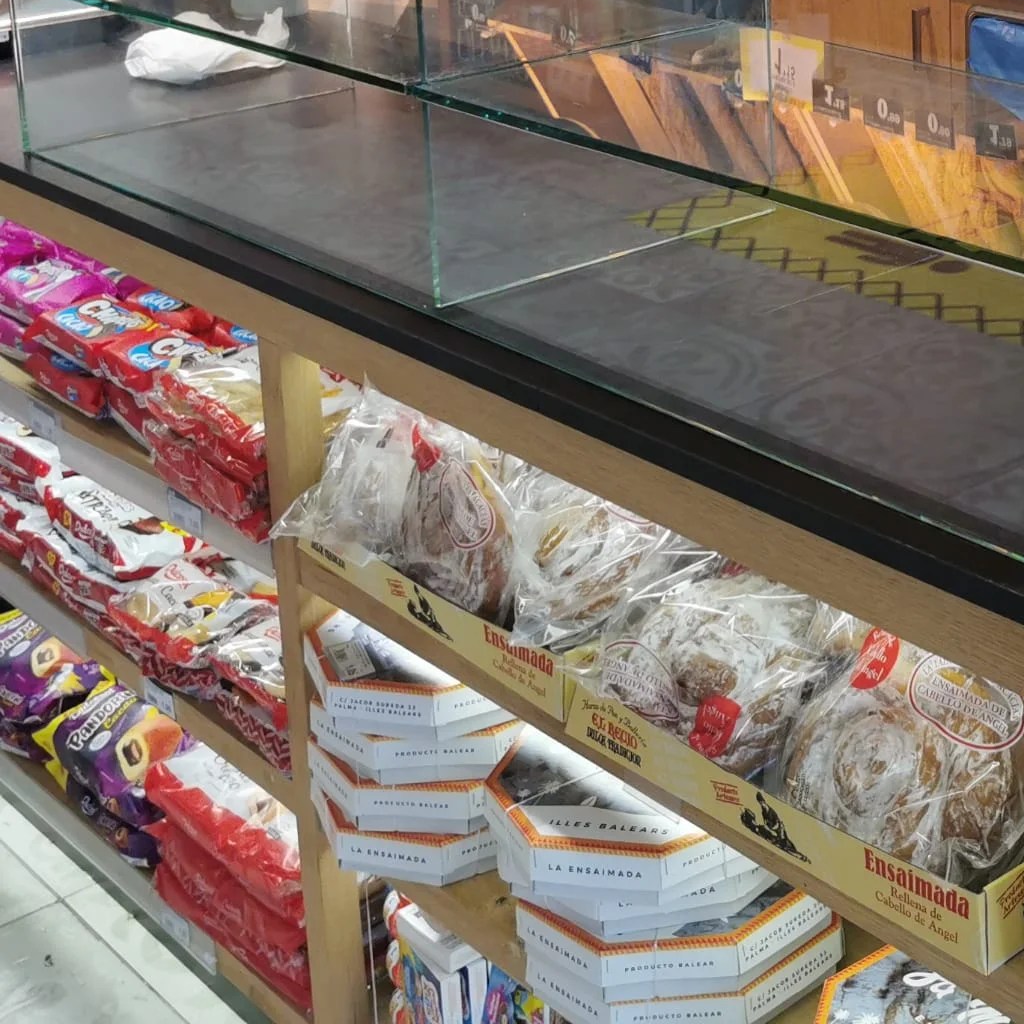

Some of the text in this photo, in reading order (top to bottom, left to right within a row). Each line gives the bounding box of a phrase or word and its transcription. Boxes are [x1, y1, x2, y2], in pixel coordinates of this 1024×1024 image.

[932, 677, 988, 712] ENSAIMADA
[549, 819, 670, 836] ILLES BALEARS
[351, 846, 427, 865] LA ENSAIMADA
[548, 863, 643, 879] LA ENSAIMADA
[864, 847, 970, 920] Ensaimada
[875, 890, 960, 945] Cabello de Angel
[890, 885, 942, 922] Rellena de
[526, 926, 589, 970] LA ENSAIMADA
[624, 960, 715, 973] PRODUCTO BALEAR
[537, 973, 599, 1018] LA ENSAIMADA
